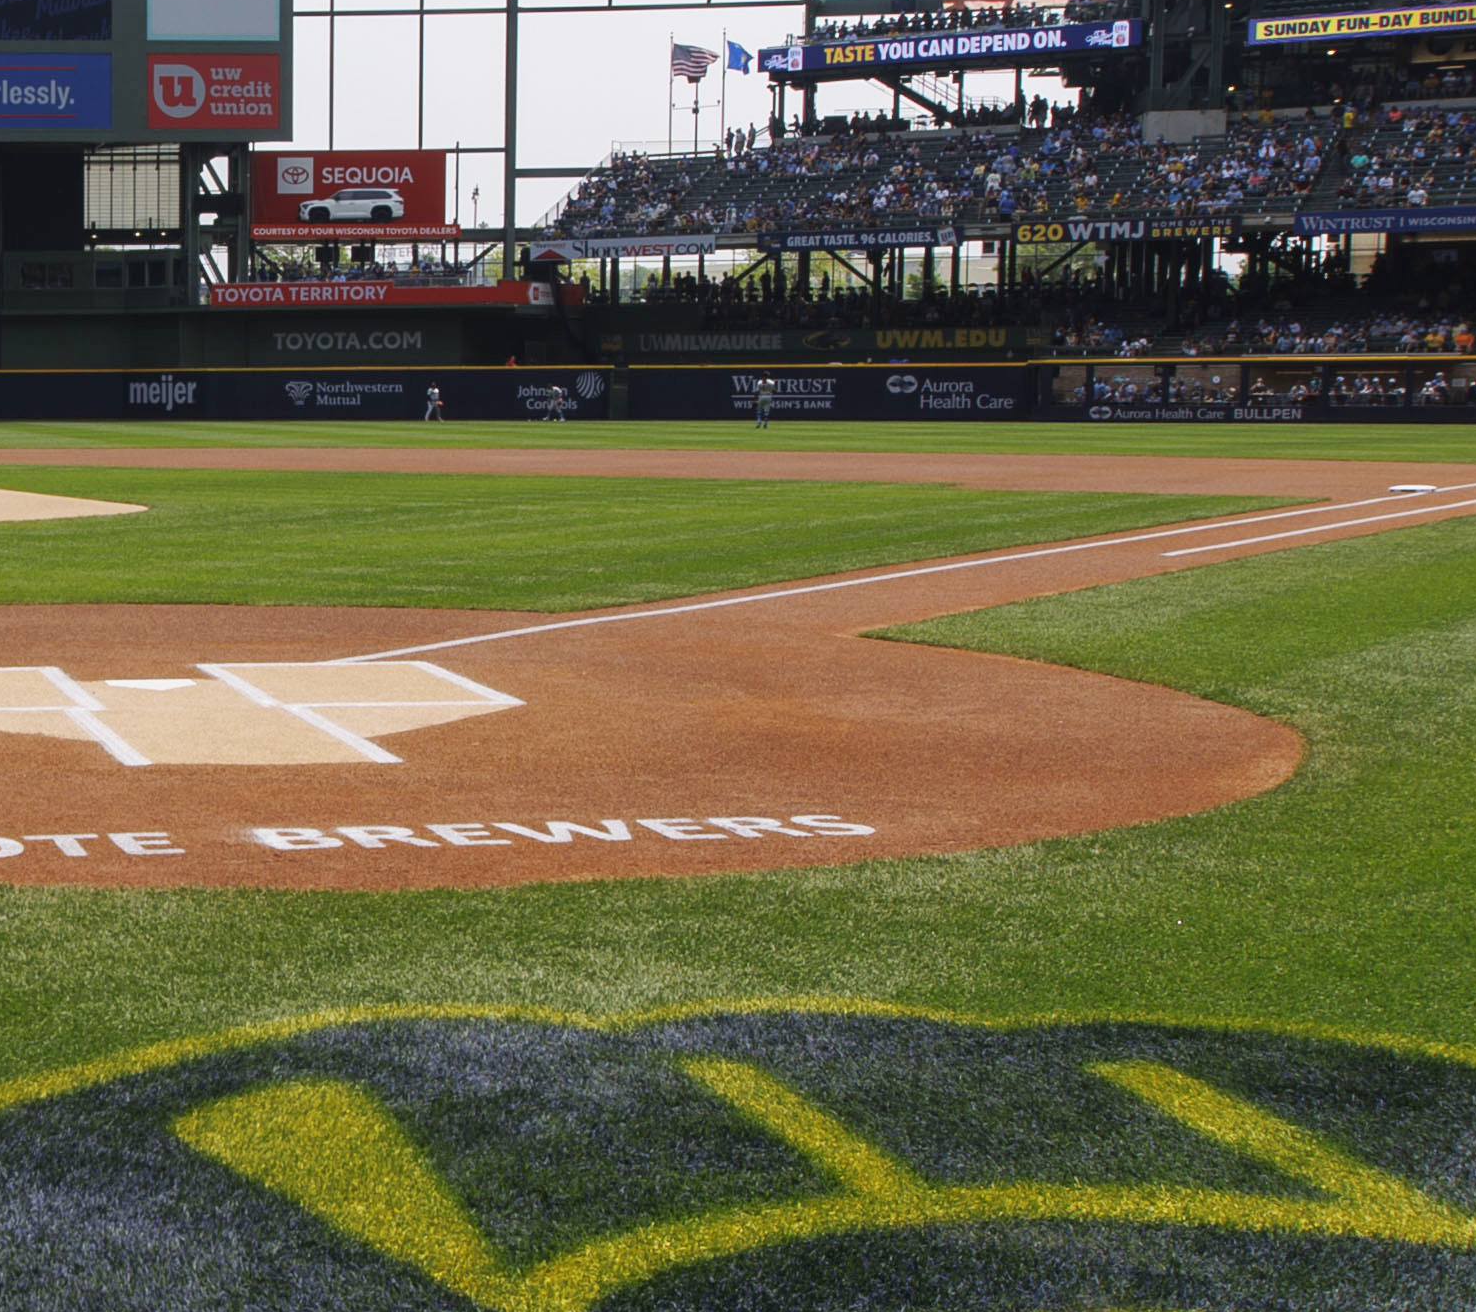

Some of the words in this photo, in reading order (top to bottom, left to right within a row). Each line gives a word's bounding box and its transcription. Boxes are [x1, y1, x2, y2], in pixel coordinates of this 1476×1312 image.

[1263, 20, 1332, 37] SUNDAY
[823, 43, 876, 65] TASTE
[879, 40, 915, 61] YOU
[918, 38, 955, 59] CAN
[957, 32, 1030, 56] DEPEND
[1033, 29, 1068, 50] ON.
[210, 67, 242, 81] uw
[210, 82, 272, 99] credit
[210, 101, 274, 117] union
[321, 166, 414, 186] SEQUOIA
[1152, 220, 1183, 228] HOME
[1300, 215, 1395, 231] WINTRUST
[253, 228, 297, 236] COURTESY
[335, 228, 385, 236] WISCONSIN
[386, 227, 418, 236] TOYOTA
[420, 227, 457, 236] DEALERS
[1017, 224, 1064, 242] 620
[1068, 221, 1145, 240] WTMJ
[1151, 226, 1233, 238] BREWERS
[787, 236, 822, 248] GREAT
[215, 286, 285, 303] TOYOTA
[289, 285, 388, 302] TERRITORY
[273, 331, 423, 351] TOYOTA.COM
[875, 328, 1007, 349] UWM.EDU
[129, 374, 197, 411] meijer
[315, 382, 403, 394] Northwestern
[921, 378, 974, 393] Aurora
[315, 393, 361, 407] Mutual
[919, 393, 971, 409] Health
[975, 394, 1015, 410] Care
[1114, 407, 1151, 419] Aurora
[1155, 407, 1194, 420] Health
[1196, 407, 1225, 420] Care
[1233, 408, 1302, 420] BULLPEN
[252, 813, 877, 852] BREWERS
